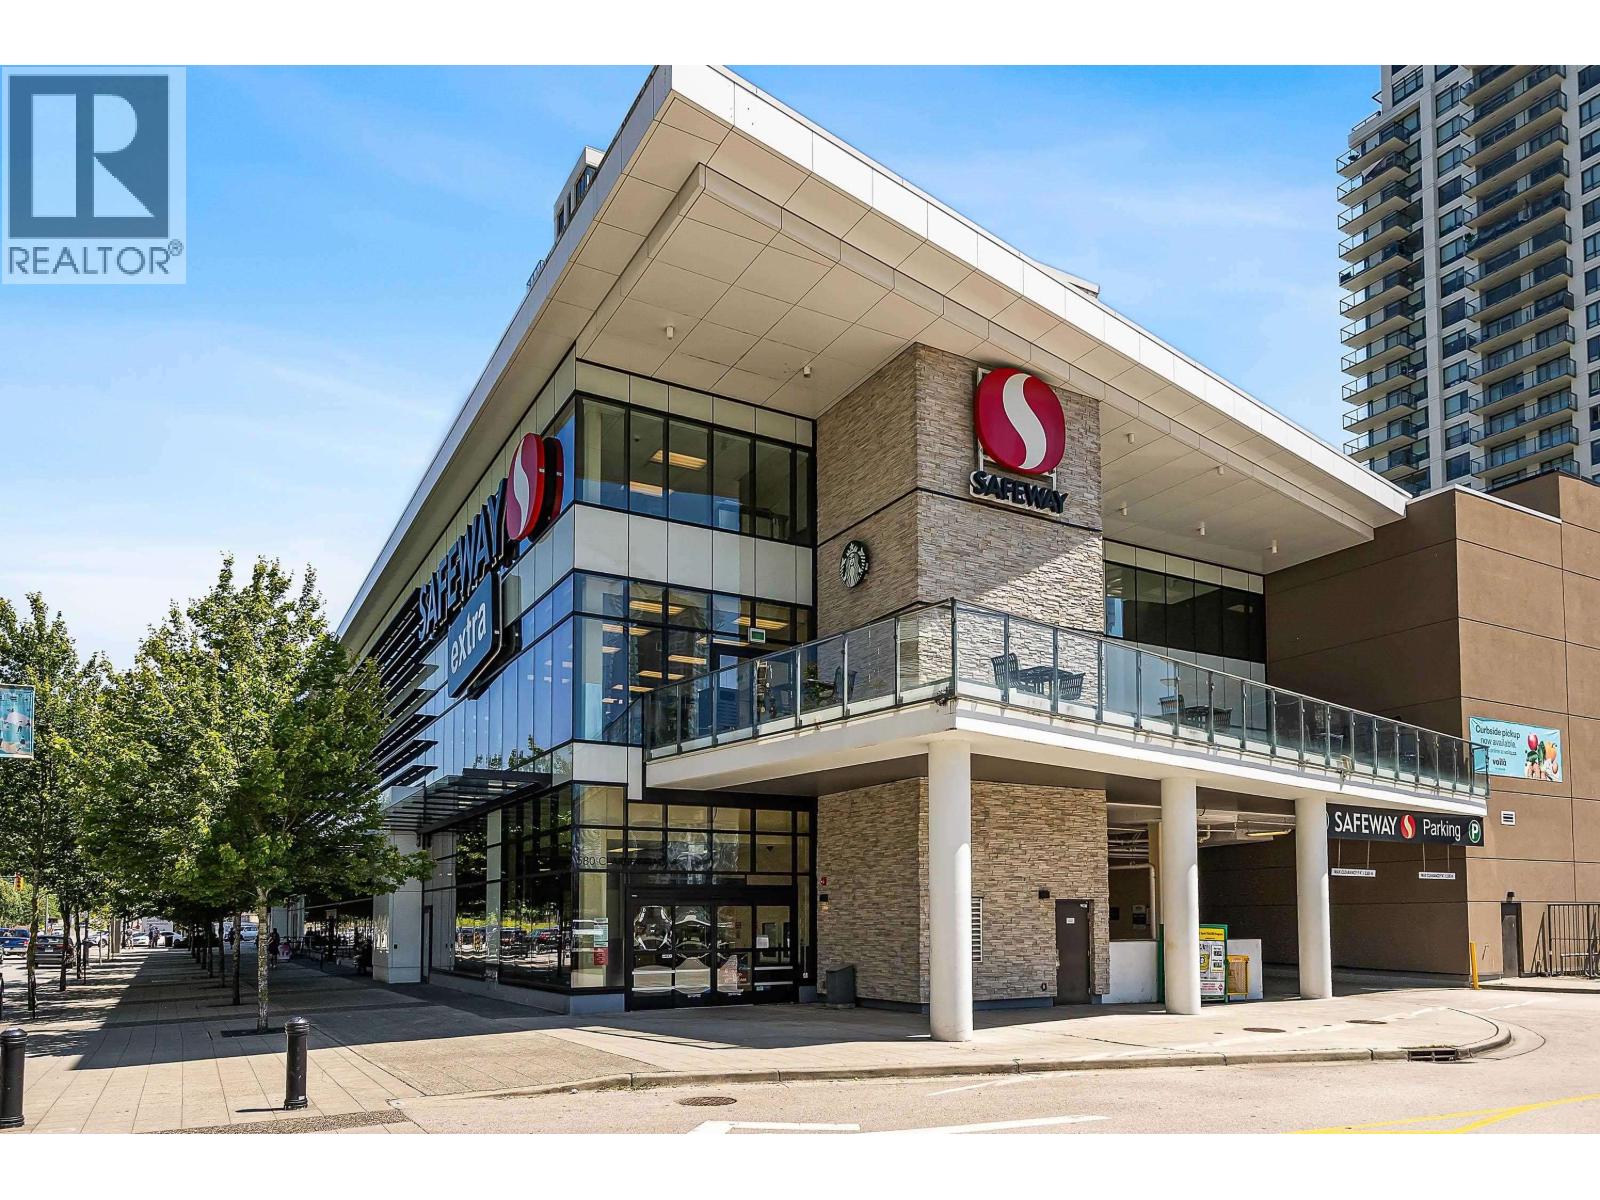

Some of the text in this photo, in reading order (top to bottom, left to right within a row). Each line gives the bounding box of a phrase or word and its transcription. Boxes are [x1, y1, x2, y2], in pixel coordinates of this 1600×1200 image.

[969, 470, 1068, 514] SAFEWAY
[418, 478, 508, 641] SAFEWAY
[451, 602, 487, 673] extra
[1475, 724, 1521, 740] Curbside pickup
[1334, 811, 1398, 836] SAFEWAY
[1423, 818, 1461, 842] Parking
